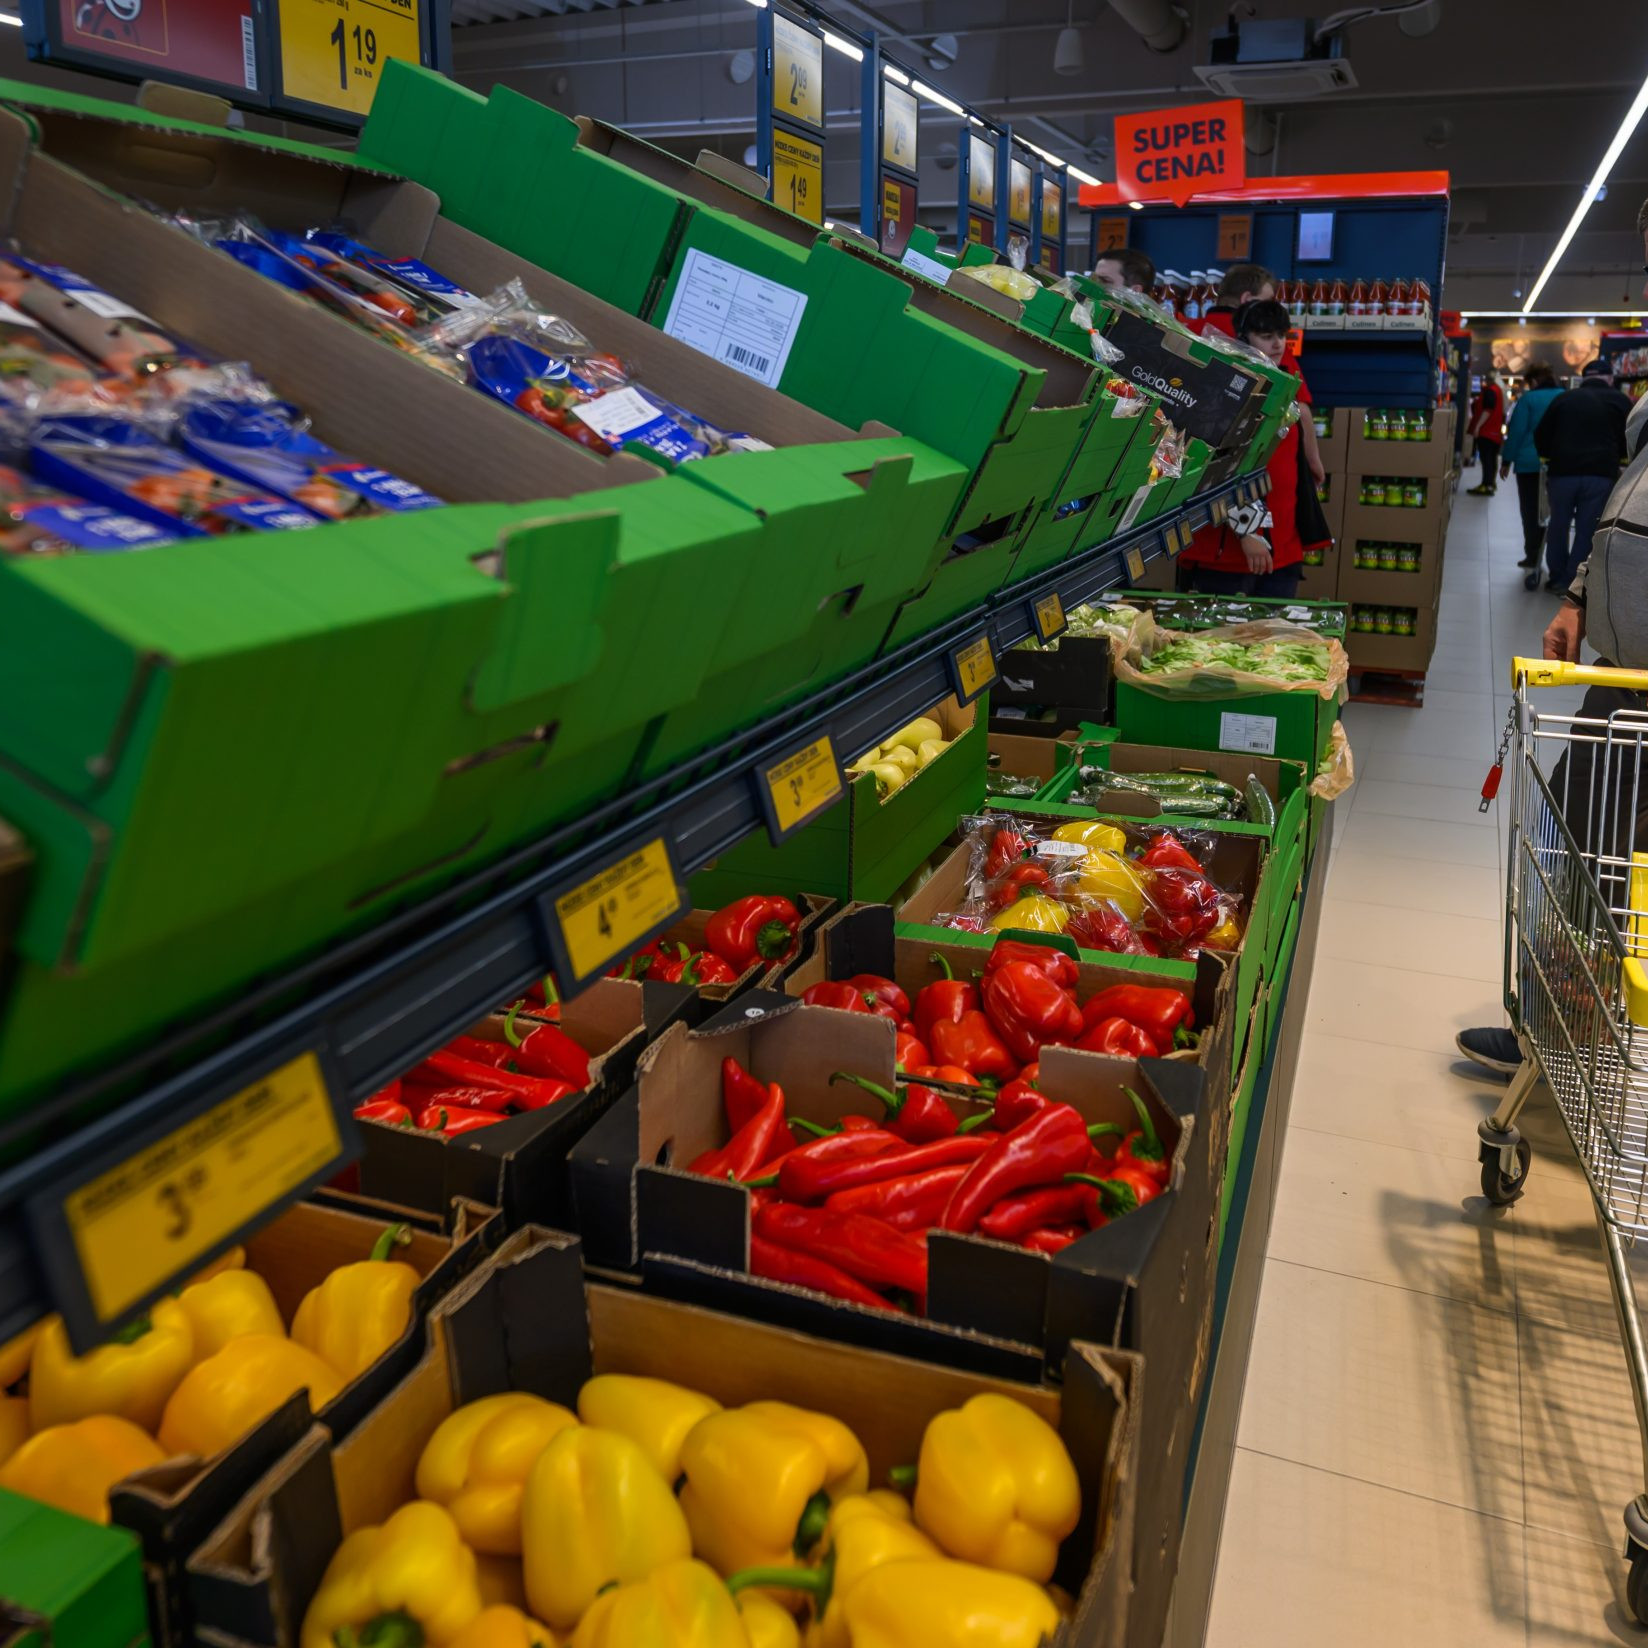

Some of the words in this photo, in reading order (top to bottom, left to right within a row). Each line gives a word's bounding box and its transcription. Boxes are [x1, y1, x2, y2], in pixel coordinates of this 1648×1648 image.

[331, 18, 347, 90] 1
[353, 25, 376, 64] 19
[790, 63, 798, 106] 2
[1133, 118, 1226, 154] SUPER
[1136, 148, 1224, 184] CENA!
[790, 174, 796, 213] 1
[798, 176, 807, 199] 49
[1231, 233, 1237, 250] 1
[1131, 365, 1198, 408] GoldQuality
[598, 902, 613, 939] 4
